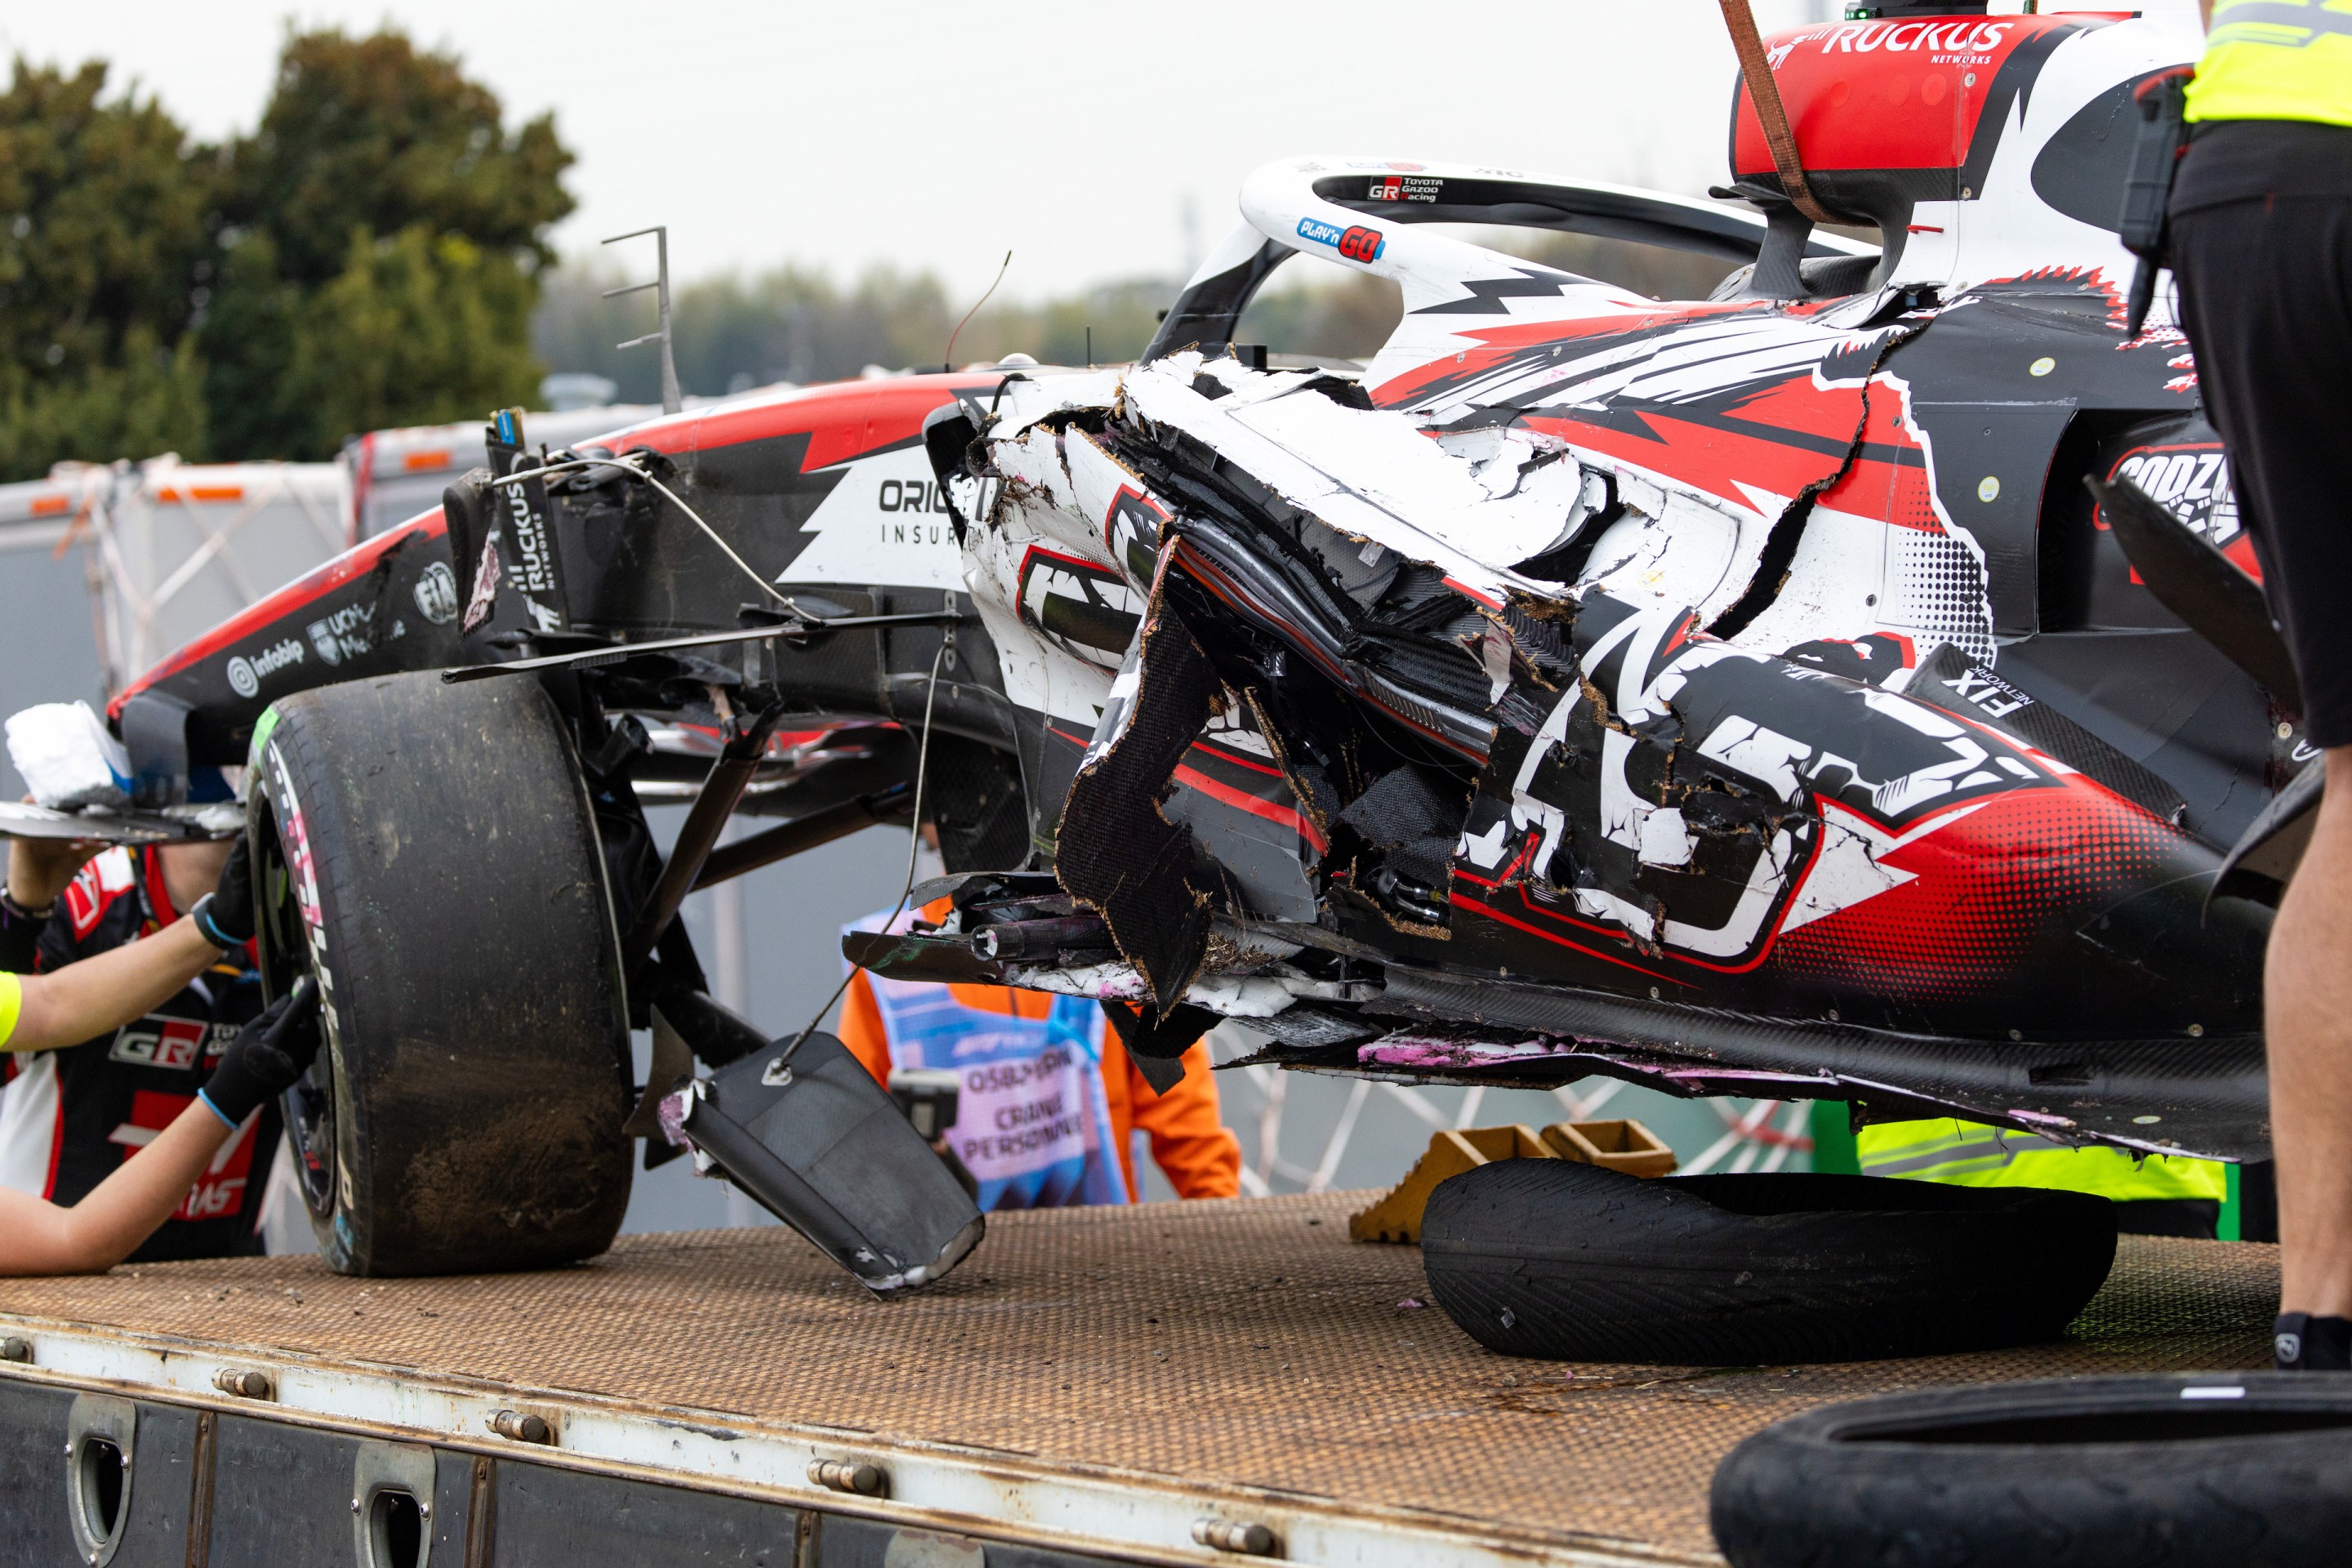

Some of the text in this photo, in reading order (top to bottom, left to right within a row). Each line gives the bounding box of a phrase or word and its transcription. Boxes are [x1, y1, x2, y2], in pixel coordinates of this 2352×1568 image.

[1821, 23, 2014, 53] RUCKUS
[1931, 55, 1991, 65] NETWORKS
[1370, 185, 1399, 199] GR
[1400, 193, 1436, 203] Racing
[1401, 185, 1438, 194] GAZOO
[1404, 177, 1443, 186] TOYOTA
[1300, 220, 1380, 262] PLAY'n GO
[506, 483, 546, 591] RUCKUS
[532, 513, 555, 590] NETWORKS
[249, 638, 304, 679] infobip
[1940, 669, 2025, 719] FIX
[1969, 666, 2035, 706] NETWORK
[118, 1031, 195, 1065] GR
